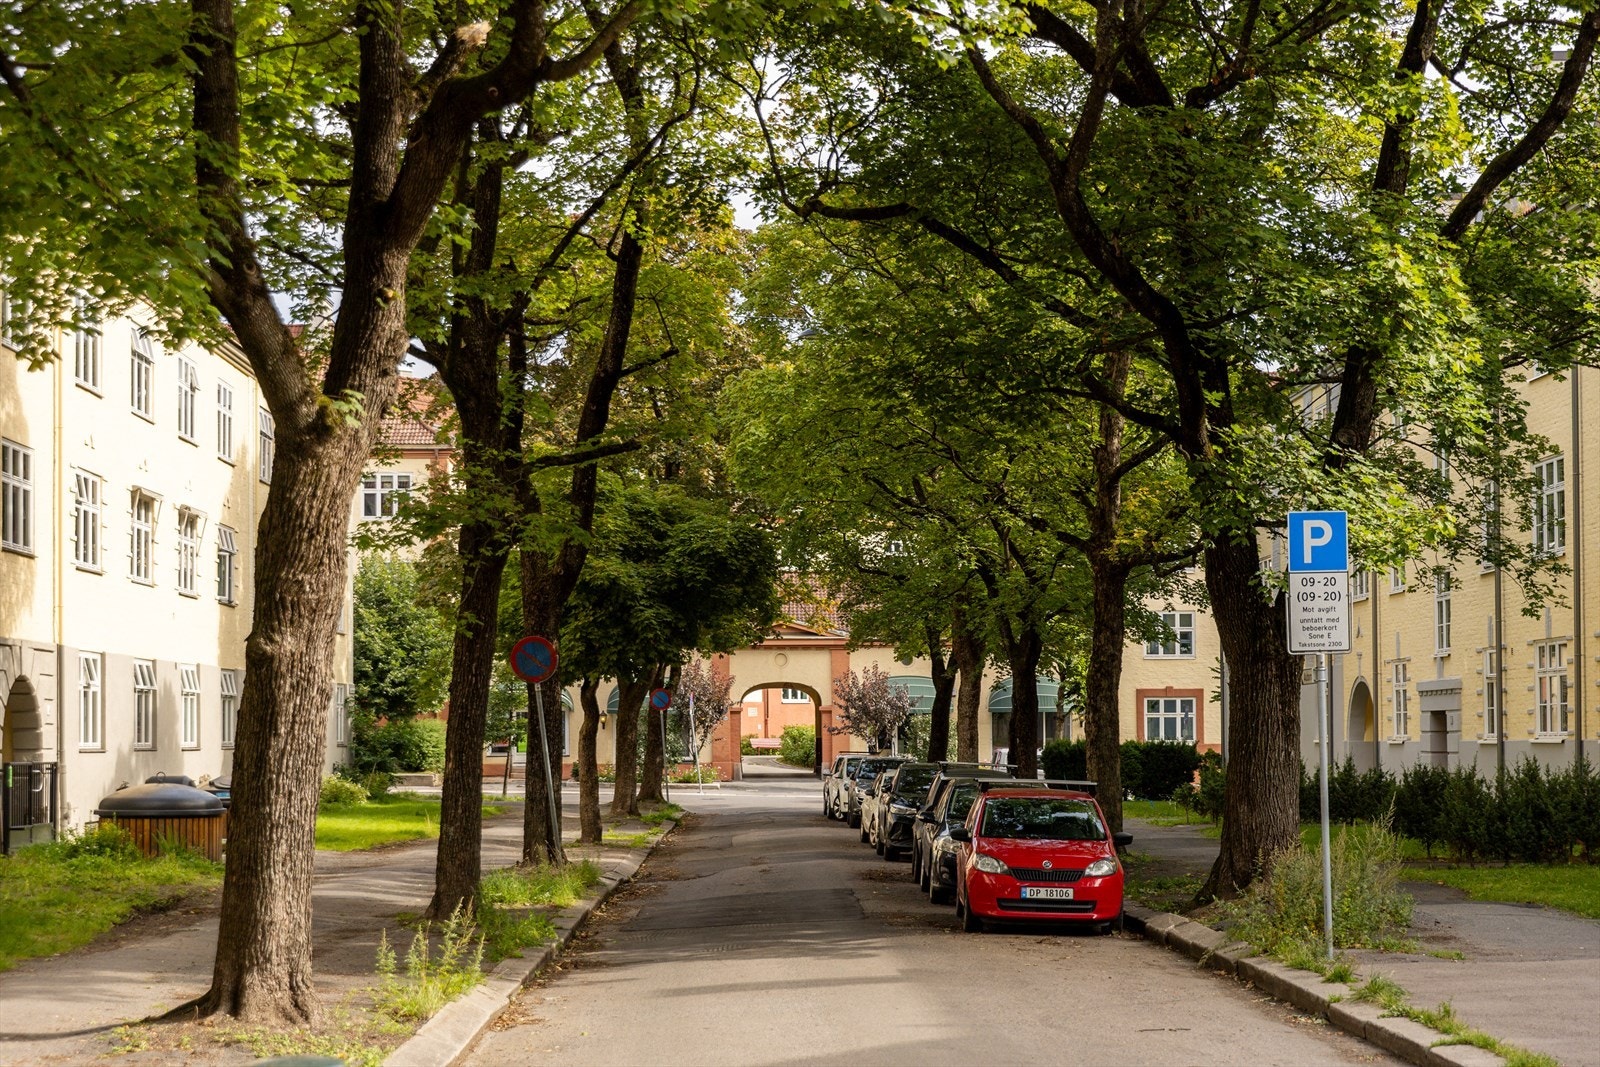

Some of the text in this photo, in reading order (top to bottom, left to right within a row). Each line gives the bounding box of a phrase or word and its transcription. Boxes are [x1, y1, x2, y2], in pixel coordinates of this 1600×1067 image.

[1302, 520, 1333, 564] P
[1029, 889, 1070, 898] DP 18106
